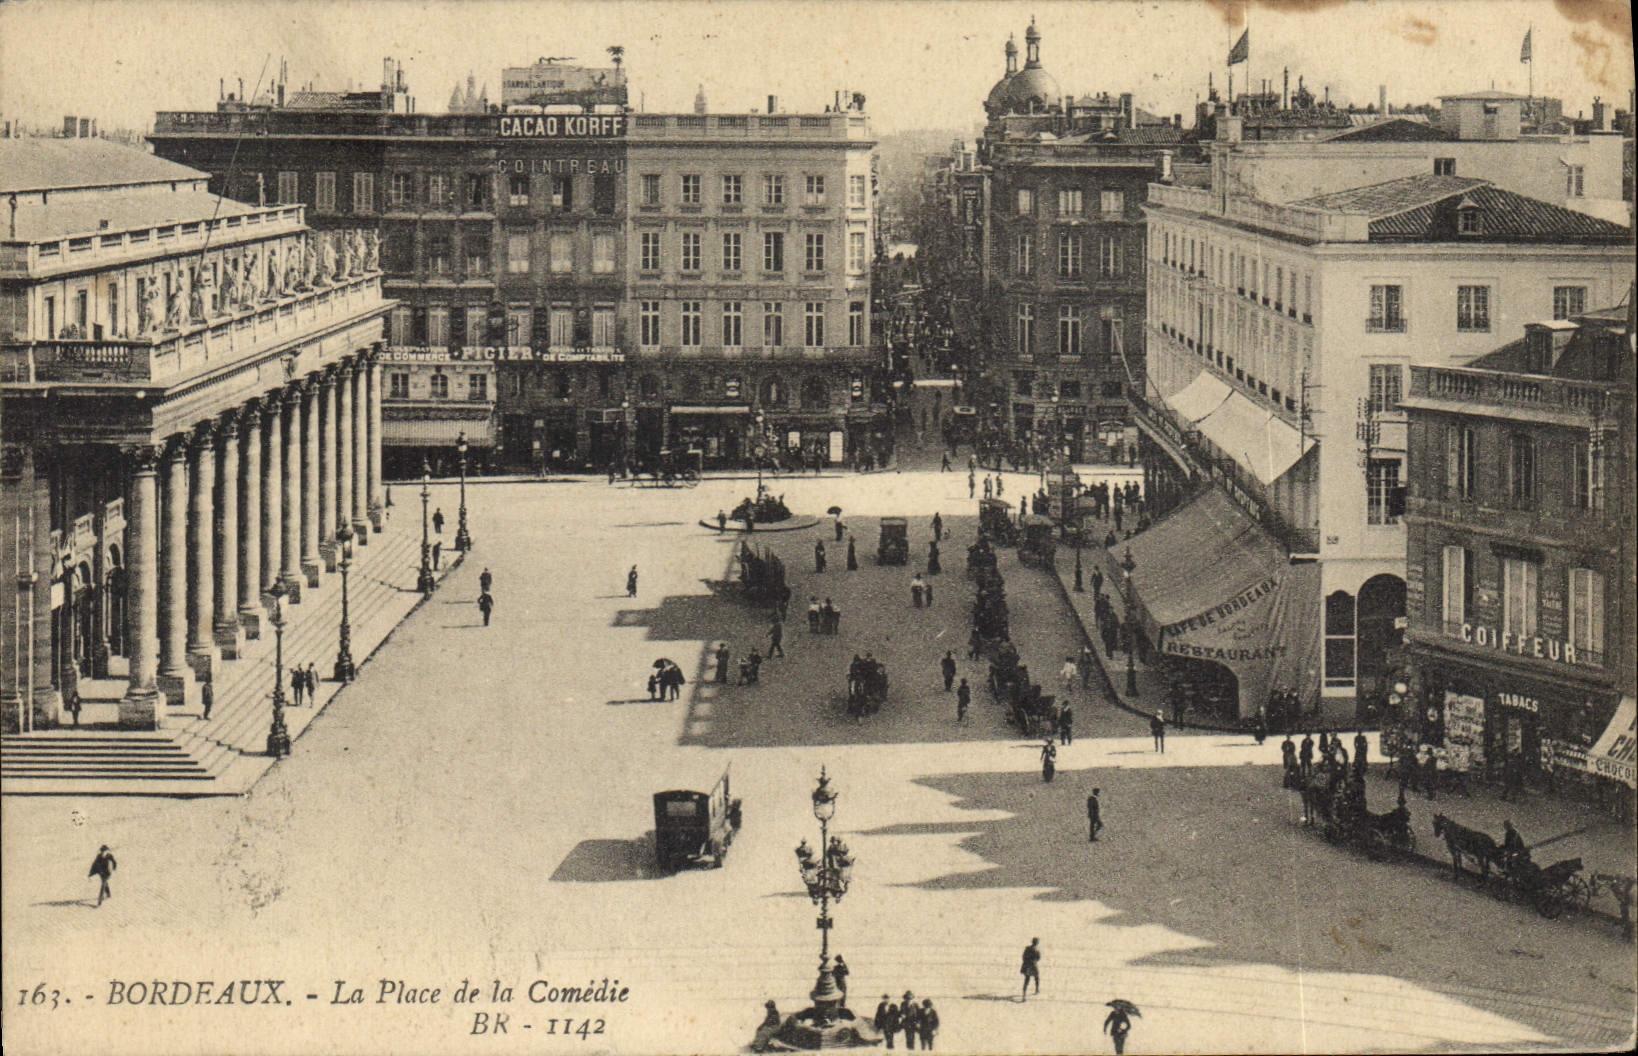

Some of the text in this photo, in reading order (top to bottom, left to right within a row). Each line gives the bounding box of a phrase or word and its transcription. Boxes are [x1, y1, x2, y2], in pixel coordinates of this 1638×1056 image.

[501, 117, 623, 137] CACAO KORFF
[498, 159, 625, 174] COINTREAU
[461, 346, 533, 360] PIGIER
[1215, 577, 1278, 619] BORDEAUX
[1167, 641, 1287, 661] RESTAURANT
[1461, 623, 1577, 665] COIFFEUR
[1498, 692, 1539, 713] TABACS
